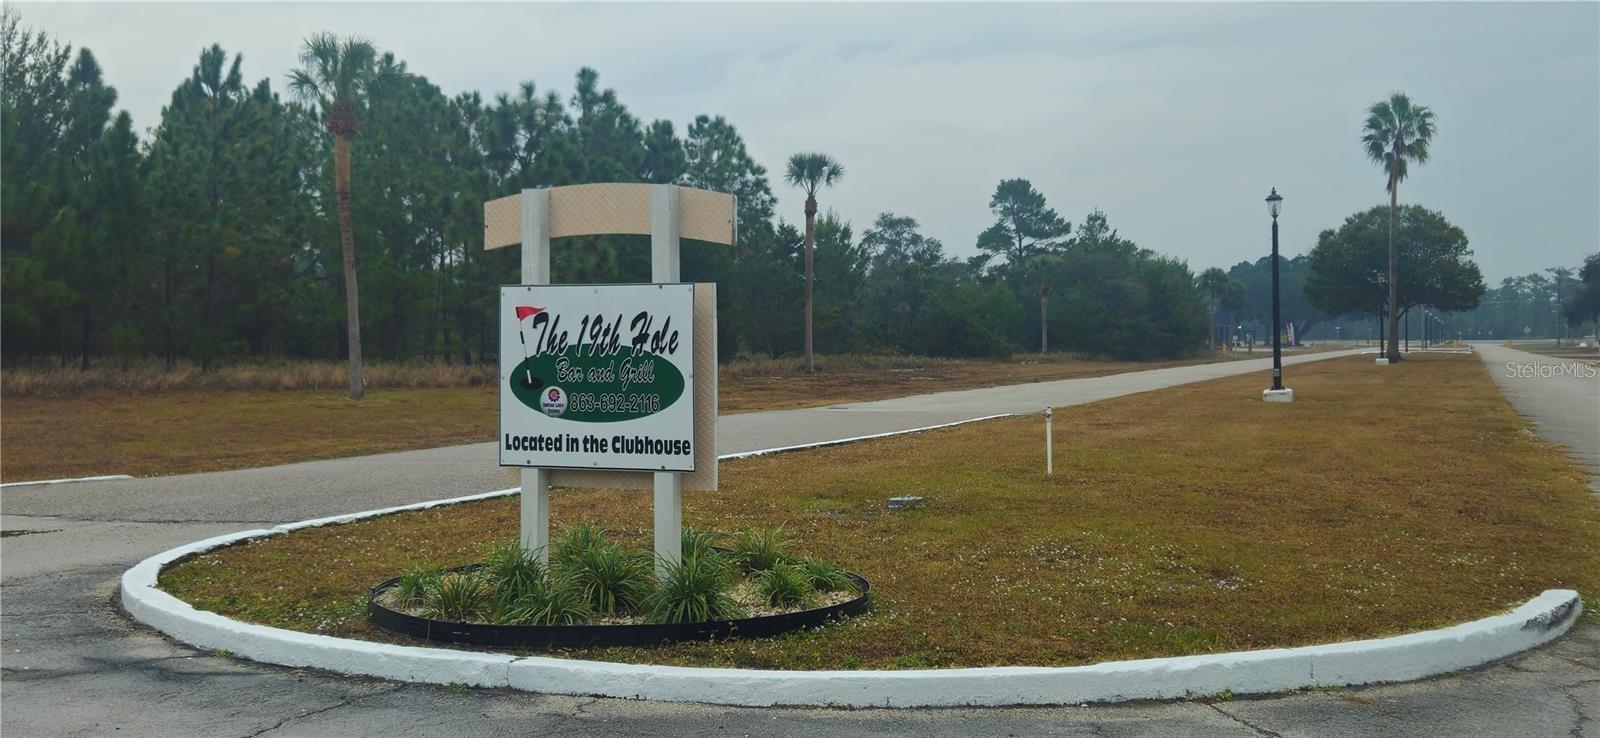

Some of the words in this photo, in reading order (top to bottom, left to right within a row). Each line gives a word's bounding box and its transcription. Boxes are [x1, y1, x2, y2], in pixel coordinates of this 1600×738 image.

[533, 311, 568, 357] The
[575, 313, 623, 357] 19th
[630, 311, 679, 357] Hole
[555, 357, 584, 383] Bar
[587, 360, 615, 383] and
[619, 357, 655, 391] Grill
[570, 392, 660, 413] 863-692-2116
[505, 433, 563, 452] Located
[566, 434, 579, 453] in
[583, 435, 608, 454] the
[611, 435, 691, 456] Clubhouse
